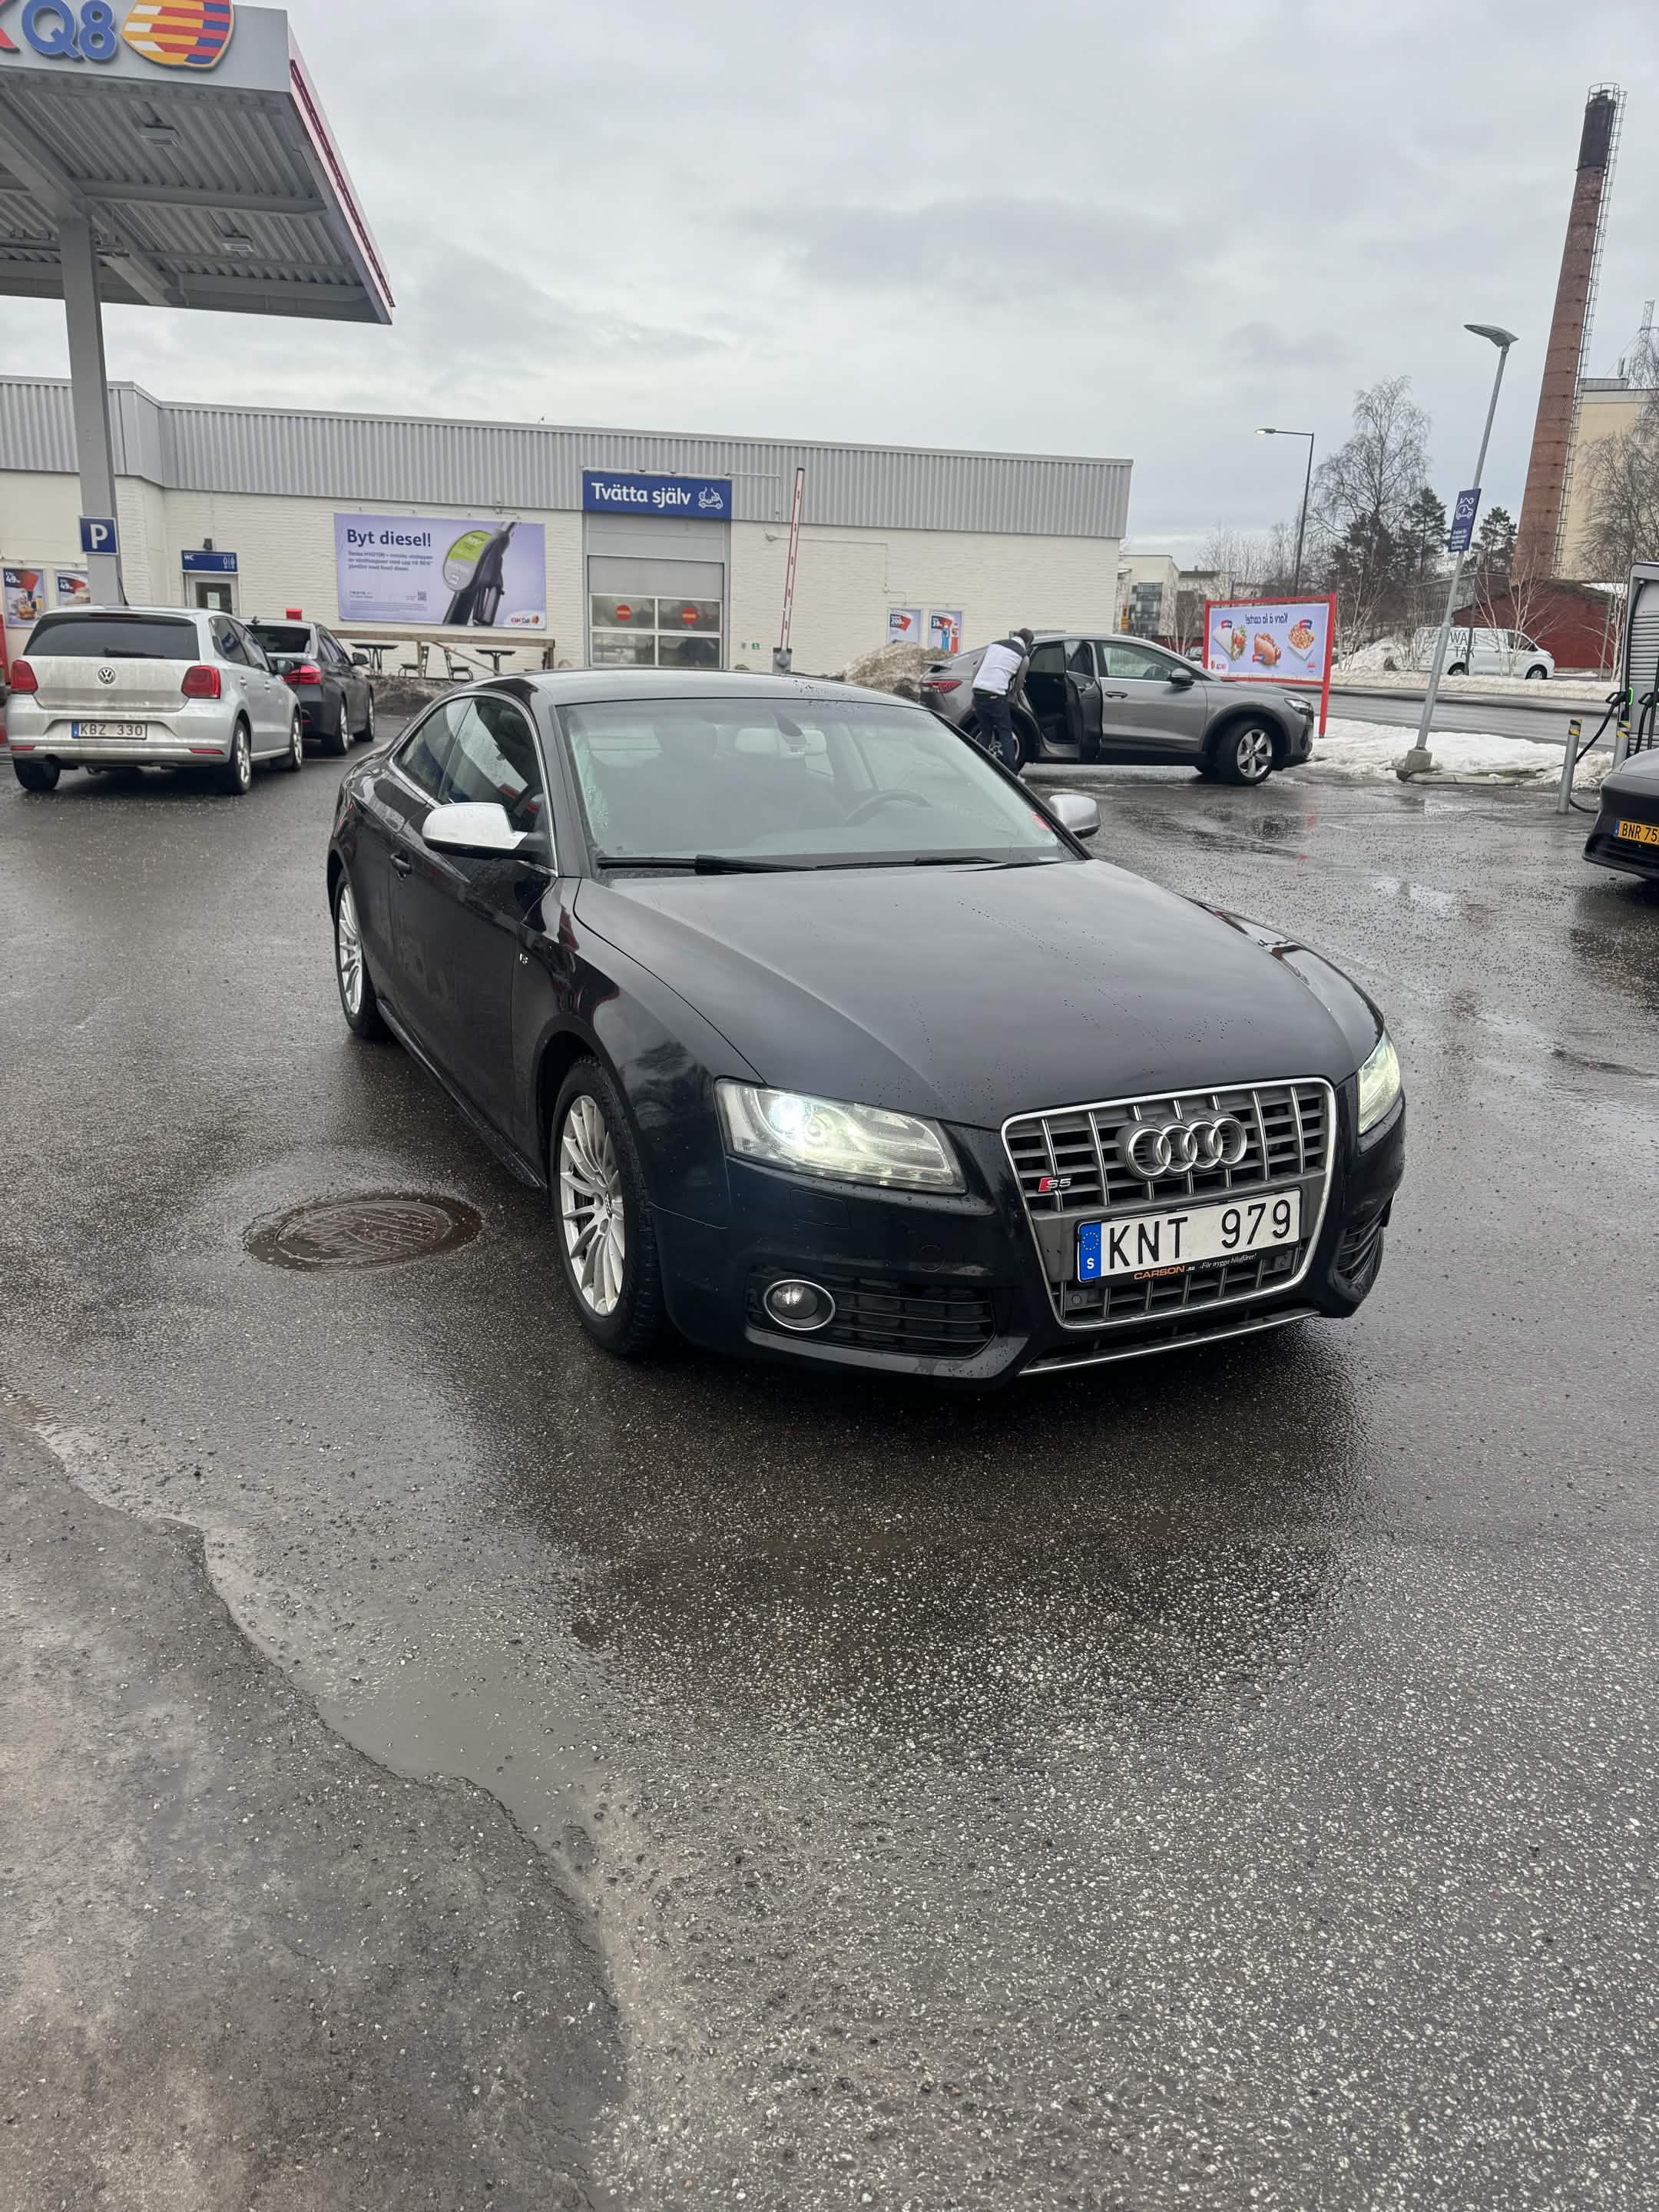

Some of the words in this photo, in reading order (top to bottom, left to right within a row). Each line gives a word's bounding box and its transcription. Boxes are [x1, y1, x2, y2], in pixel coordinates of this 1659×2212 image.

[0, 0, 117, 59] Q8
[591, 482, 648, 503] Tvätta
[652, 487, 691, 509] själv
[89, 523, 108, 550] P
[347, 528, 375, 548] Byt
[379, 530, 431, 548] diesel!
[1450, 632, 1478, 645] WAL
[80, 724, 106, 736] KBZ
[117, 724, 143, 736] 330
[1621, 823, 1641, 839] BNR
[1644, 826, 1659, 843] 75
[1046, 1177, 1072, 1189] S5
[1108, 1216, 1189, 1270] KNT
[1220, 1199, 1291, 1250] 979
[1086, 1257, 1094, 1270] S
